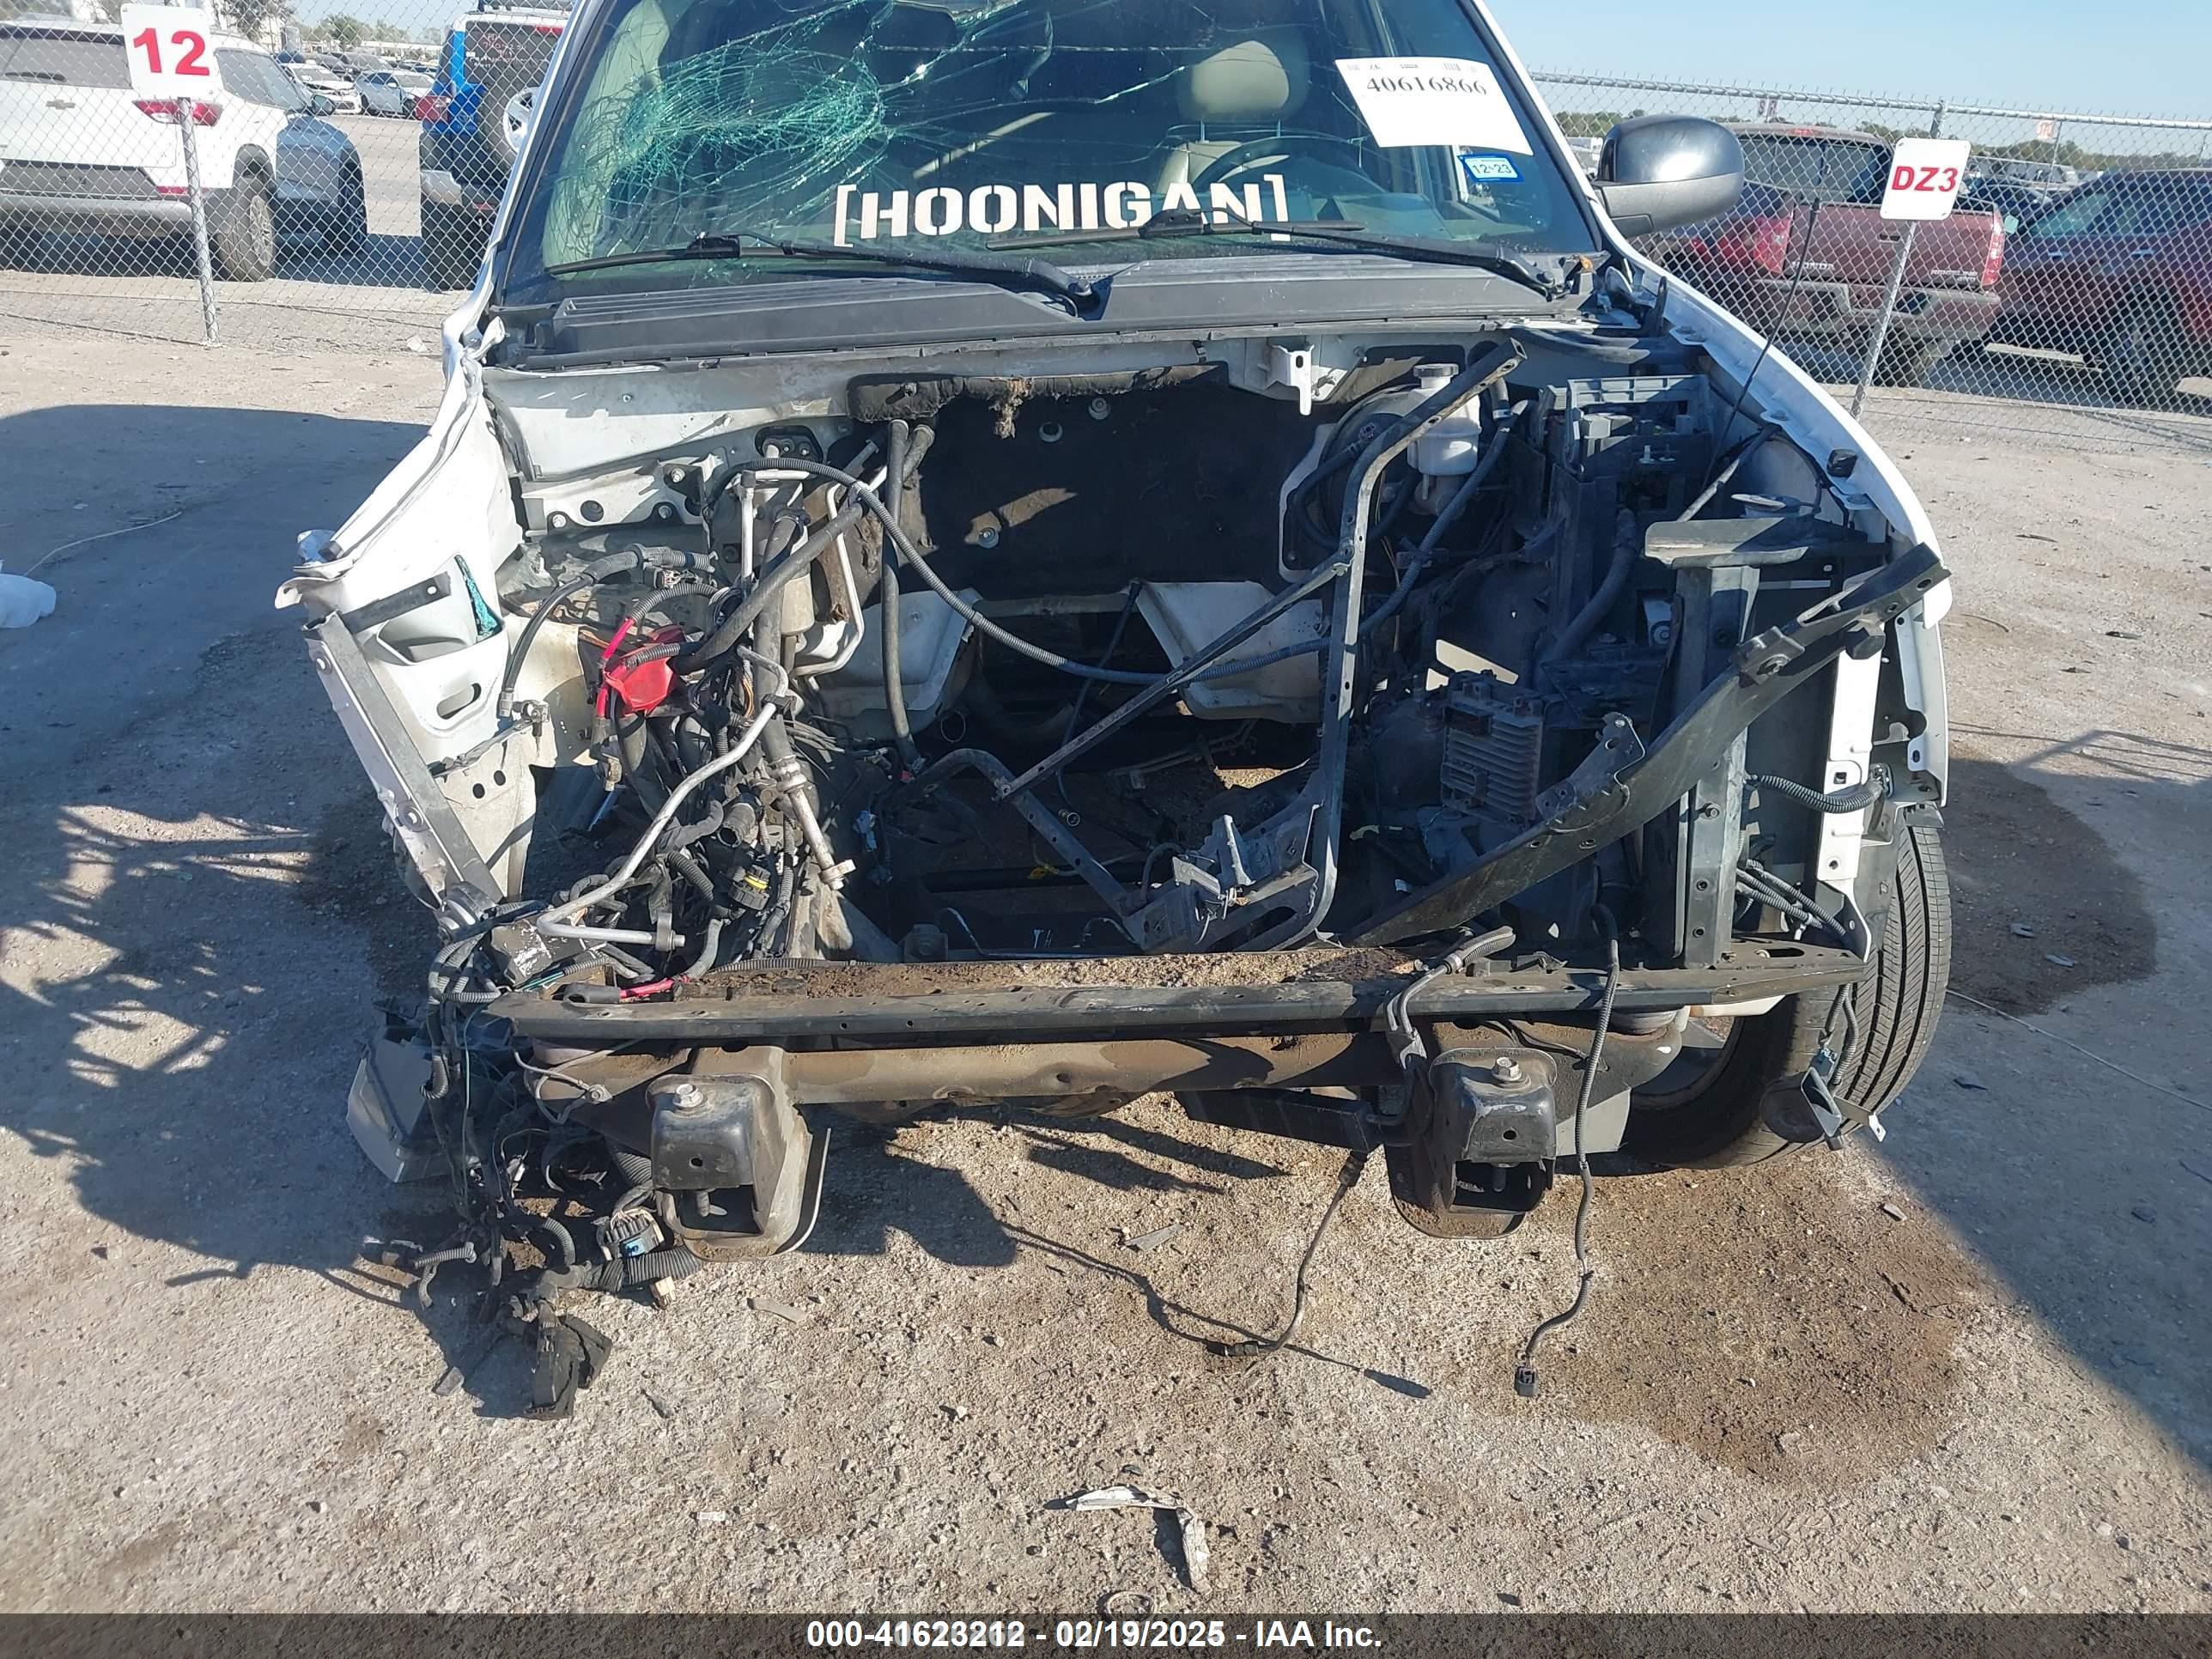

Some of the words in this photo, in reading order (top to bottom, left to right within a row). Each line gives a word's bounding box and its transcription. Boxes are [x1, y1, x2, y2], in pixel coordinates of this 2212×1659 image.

[133, 27, 210, 76] 12
[1366, 76, 1487, 96] 40616866
[1891, 165, 1959, 193] DZ3
